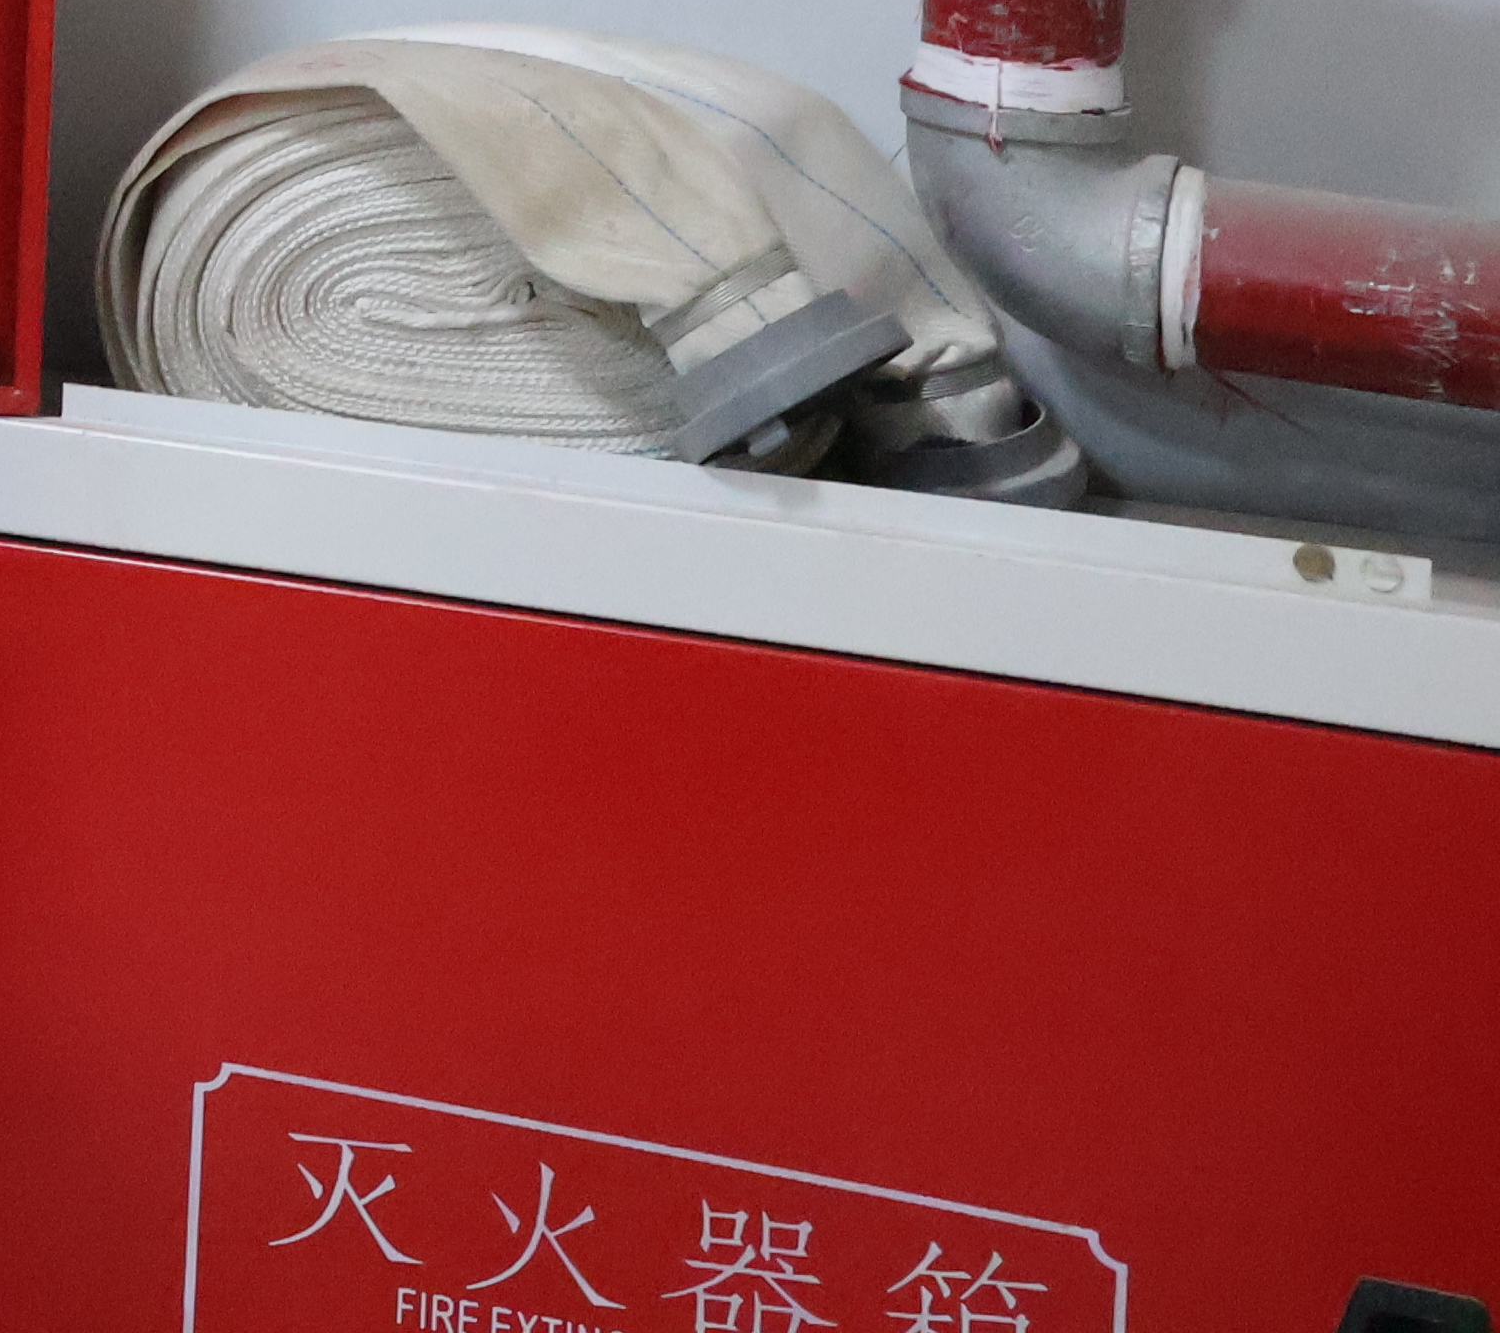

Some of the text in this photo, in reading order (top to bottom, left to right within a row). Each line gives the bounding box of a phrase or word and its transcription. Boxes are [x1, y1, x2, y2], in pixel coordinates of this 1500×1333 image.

[269, 1132, 1049, 1333] 灭火器箱
[396, 1287, 479, 1333] FIRE
